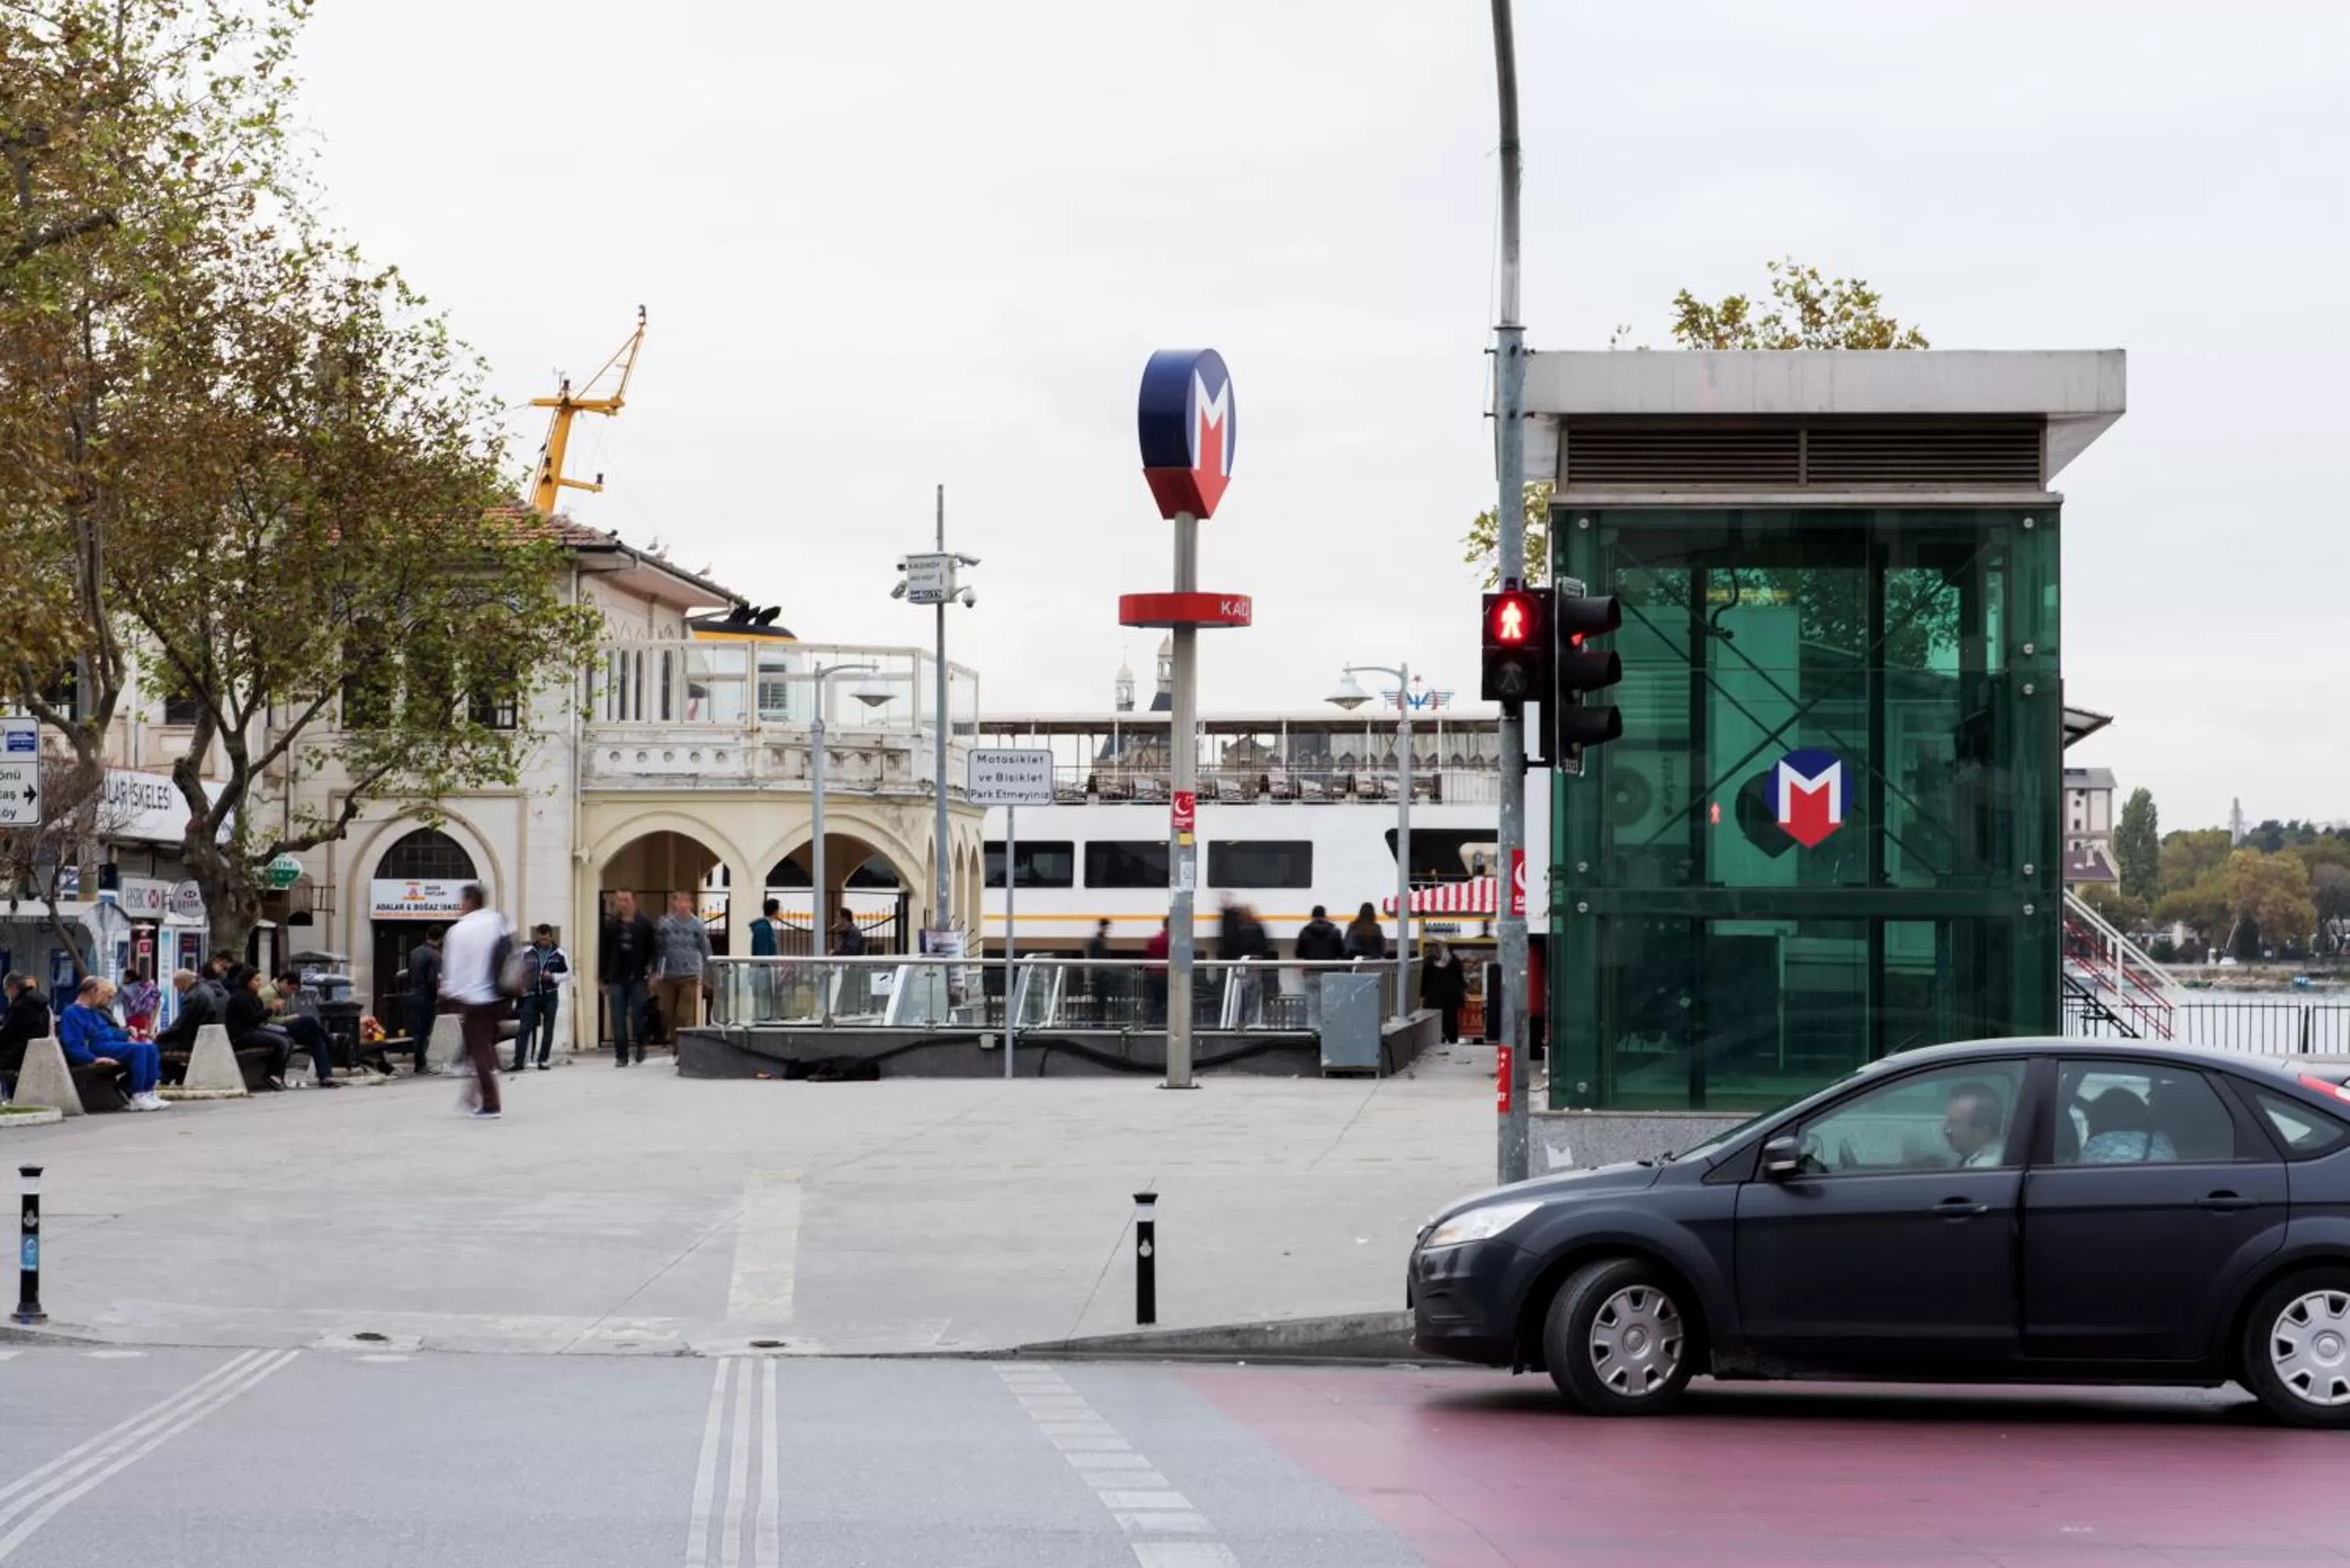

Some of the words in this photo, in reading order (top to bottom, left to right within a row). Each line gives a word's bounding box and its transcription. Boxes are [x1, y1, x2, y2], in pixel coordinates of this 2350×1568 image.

[977, 754, 1044, 764] Motosiklet
[996, 772, 1043, 782] Bisiklet
[971, 789, 993, 798] Park
[996, 789, 1050, 802] Etmeyiniz
